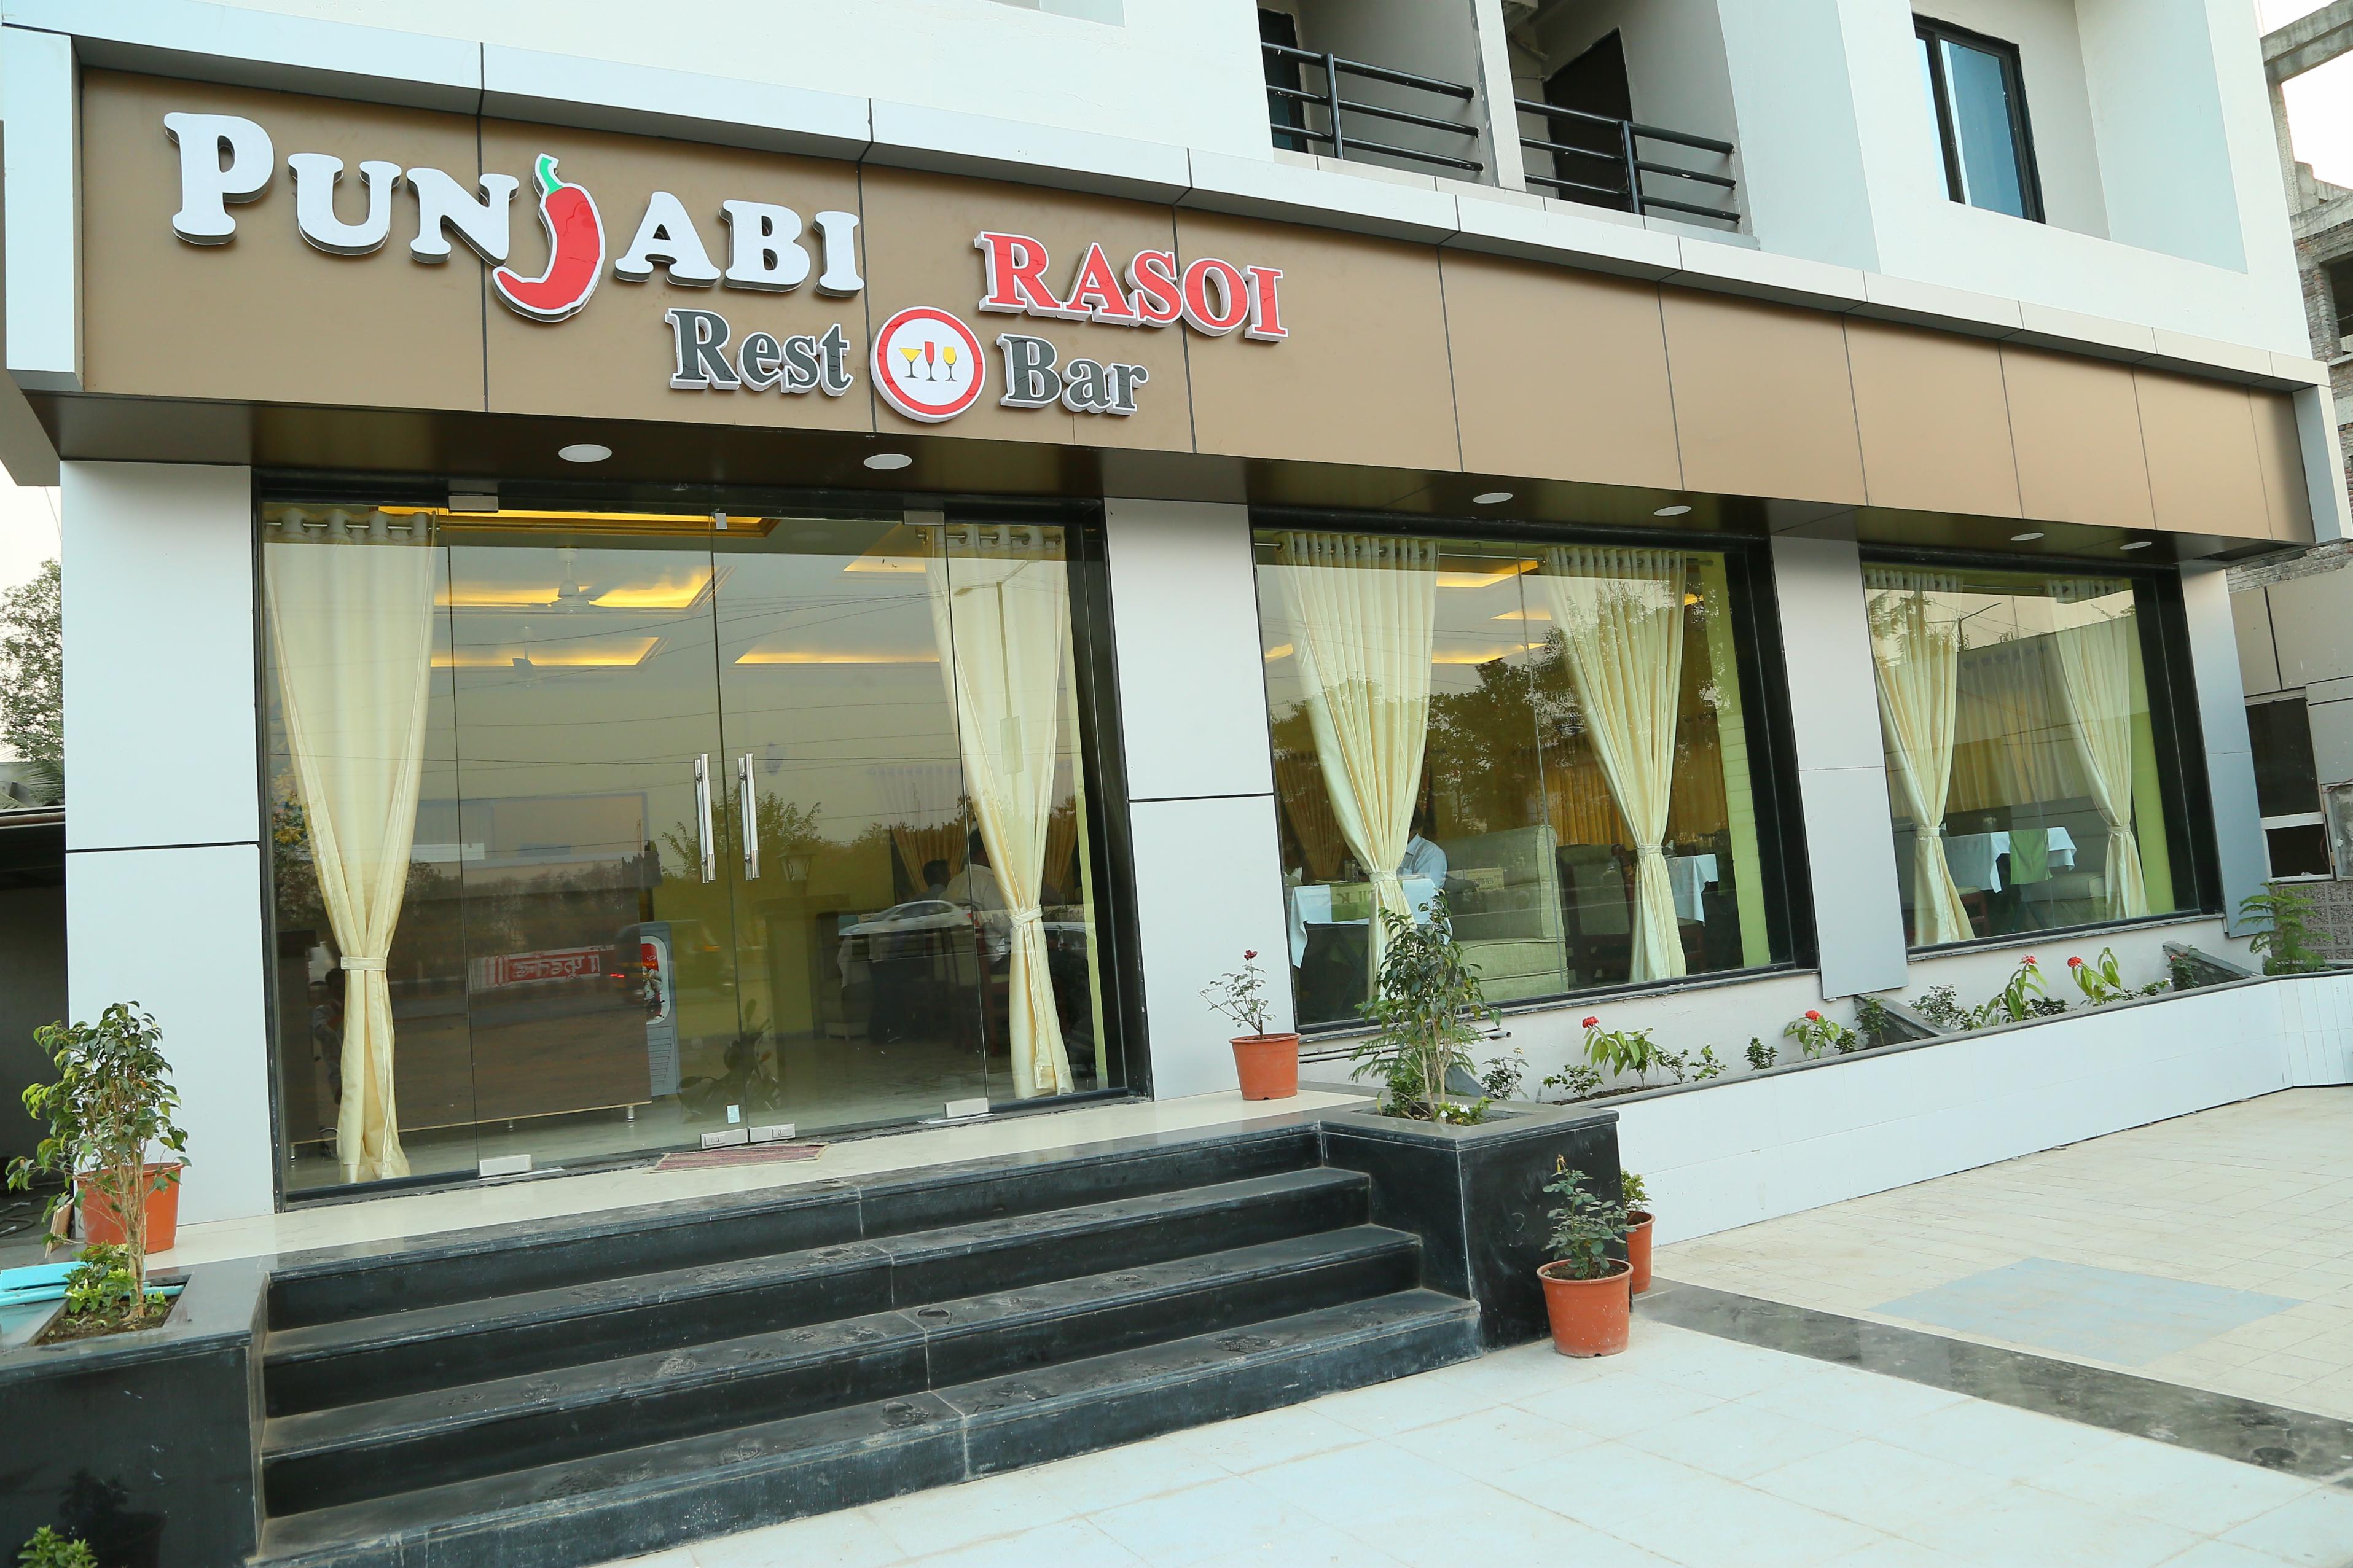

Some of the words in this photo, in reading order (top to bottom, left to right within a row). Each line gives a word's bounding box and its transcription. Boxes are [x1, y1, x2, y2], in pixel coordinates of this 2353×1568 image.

[164, 112, 864, 322] PUNJABI
[974, 230, 1288, 343] RASOI
[664, 307, 854, 397] Rest
[996, 333, 1149, 416] Bar
